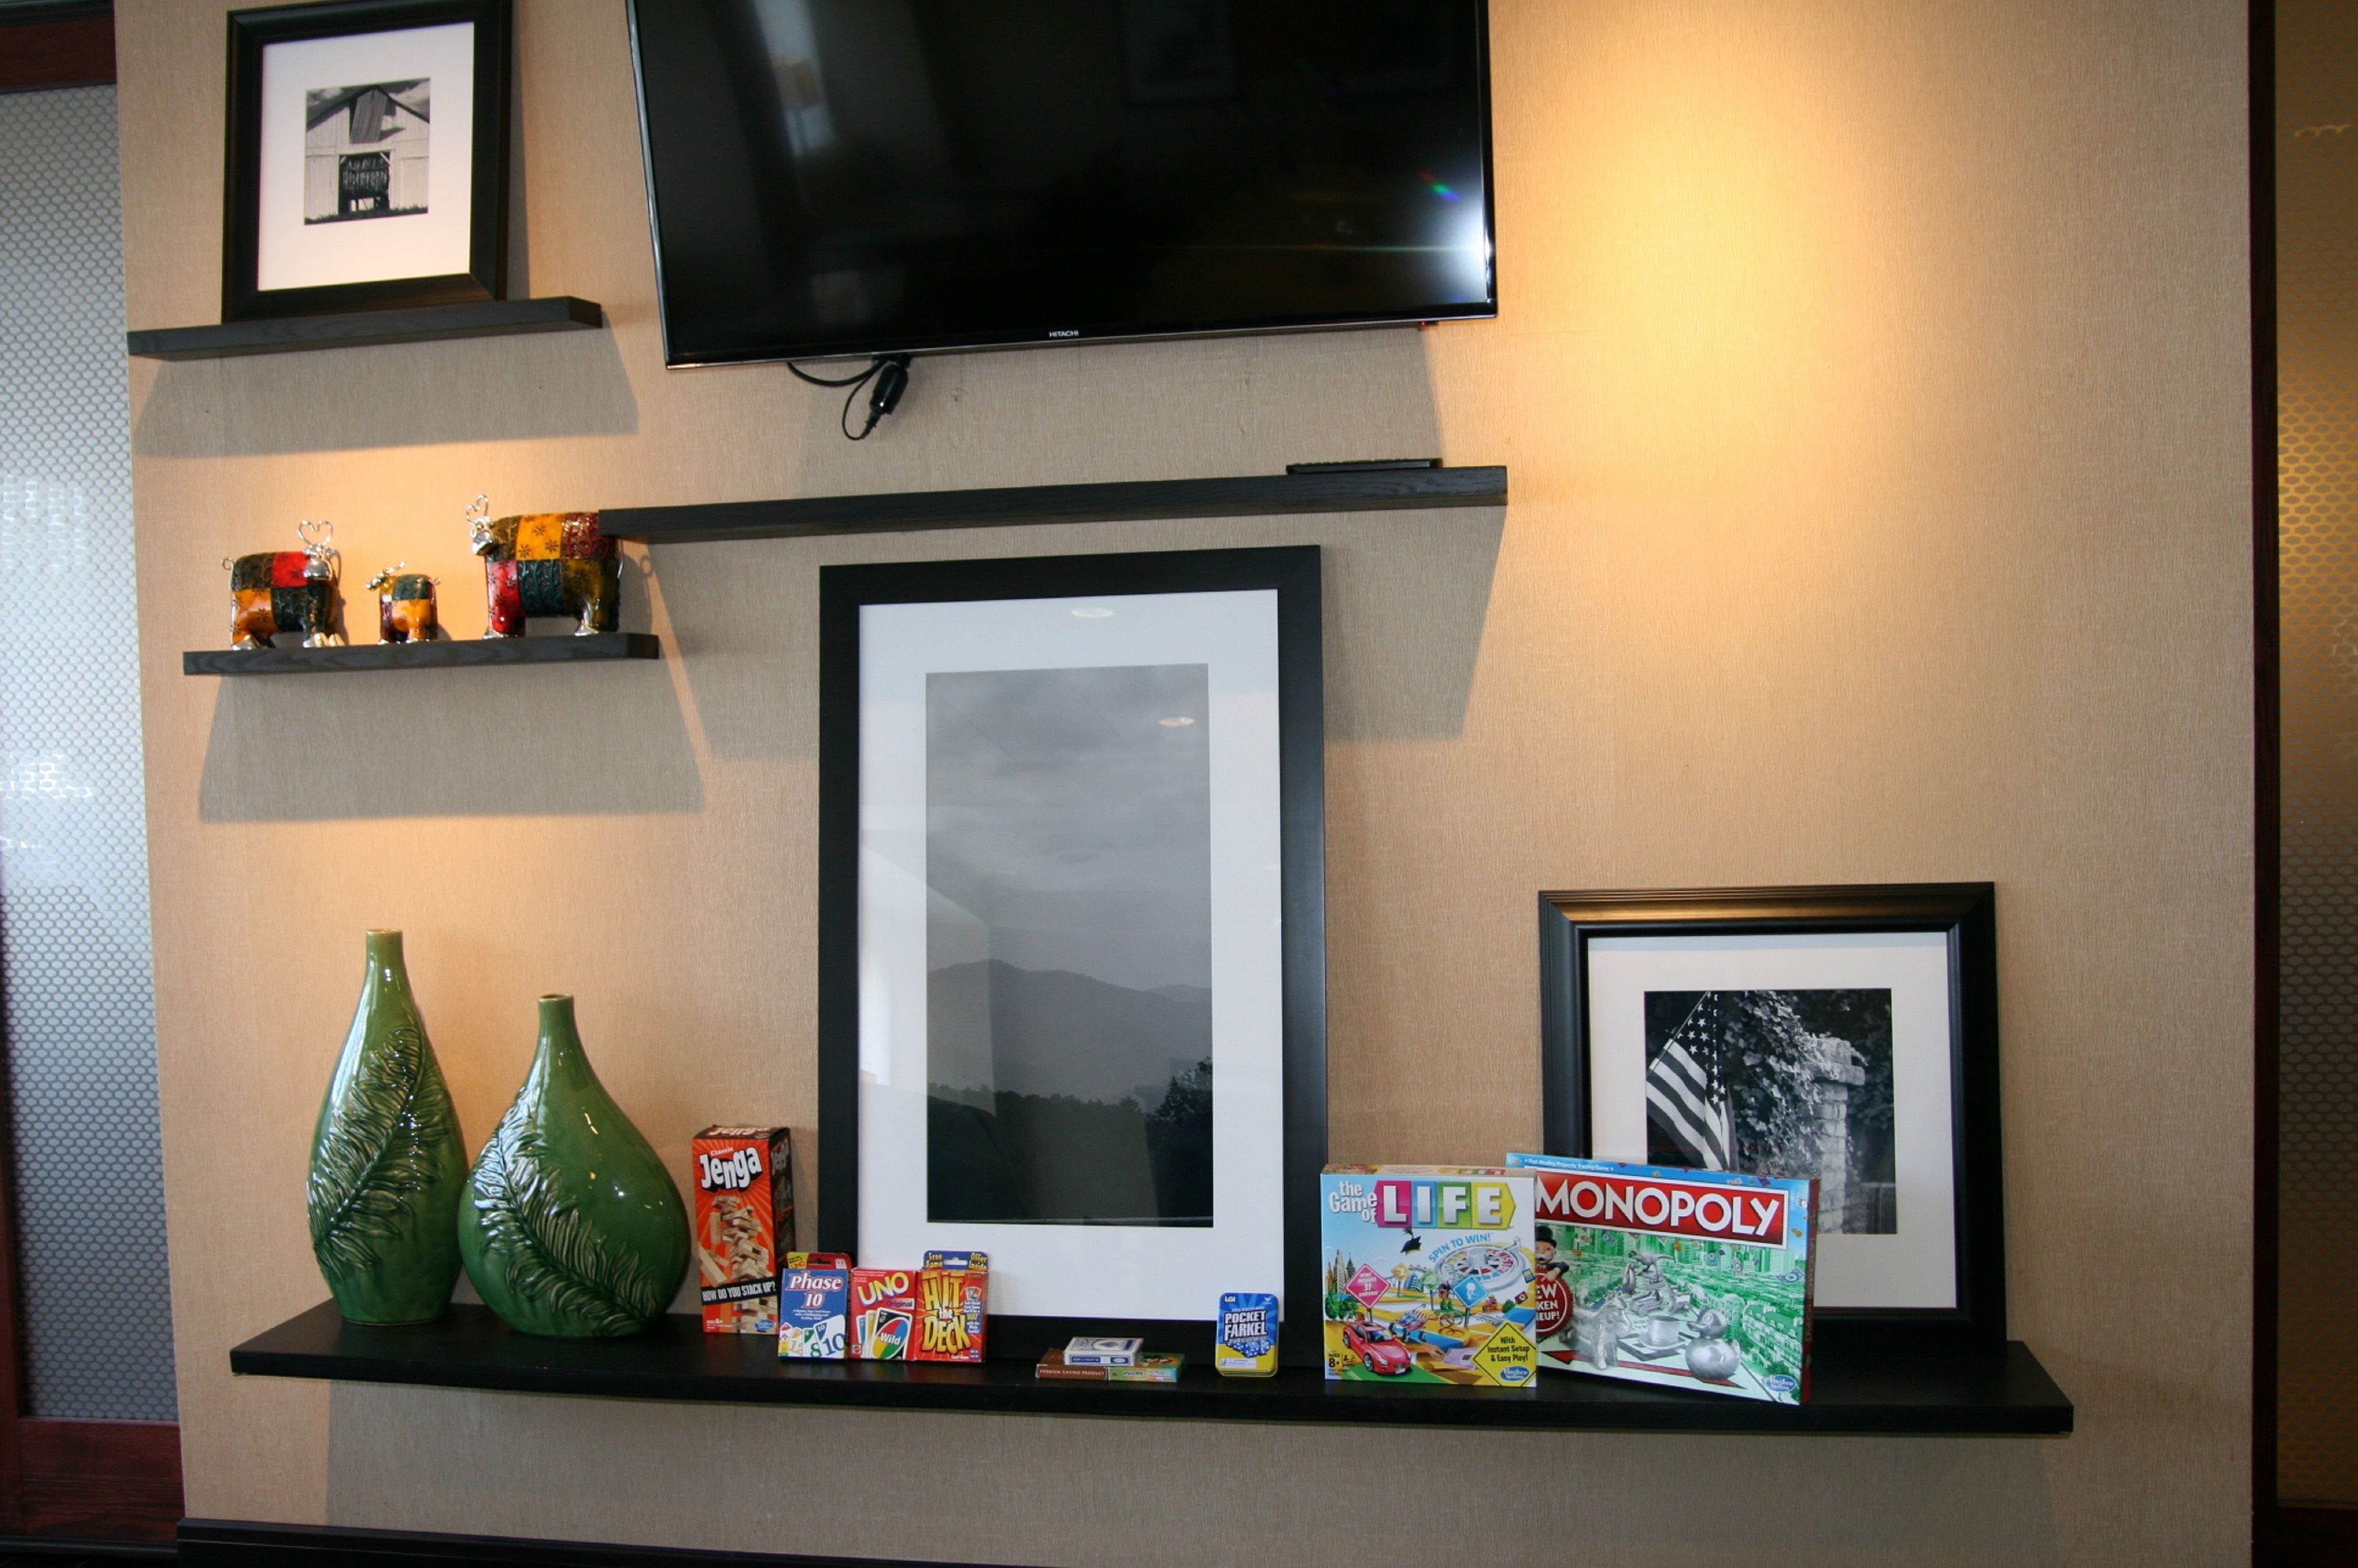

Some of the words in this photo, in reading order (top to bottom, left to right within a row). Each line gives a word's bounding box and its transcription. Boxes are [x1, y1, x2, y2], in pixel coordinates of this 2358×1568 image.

[710, 1146, 734, 1155] Classic
[699, 1147, 763, 1189] Jenga
[1339, 1181, 1362, 1196] the
[1329, 1191, 1377, 1213] Game
[1383, 1185, 1501, 1224] LIFE
[1536, 1175, 1780, 1236] MONOPOLY
[1362, 1209, 1377, 1223] of
[1428, 1243, 1450, 1262] SPIN
[1450, 1238, 1463, 1248] TO
[1465, 1233, 1491, 1243] WIN!
[968, 1260, 987, 1270] Inside
[970, 1252, 987, 1263] Offer
[786, 1271, 843, 1291] Phase
[857, 1272, 909, 1306] UNO
[702, 1290, 717, 1301] HOW
[717, 1289, 728, 1300] DO
[727, 1286, 741, 1298] YOU
[741, 1283, 763, 1296] STACK
[762, 1281, 776, 1293] UP?
[921, 1271, 965, 1311] HIT
[1536, 1283, 1557, 1299] EW
[802, 1292, 825, 1308] 10
[1536, 1300, 1558, 1310] KEN
[938, 1305, 953, 1320] the
[1224, 1310, 1266, 1324] POCKET
[1536, 1311, 1560, 1321] EUP!
[880, 1332, 902, 1346] Wild
[921, 1314, 971, 1354] DECK
[1224, 1322, 1267, 1341] FARKEL
[823, 1333, 846, 1356] 10
[1511, 1345, 1530, 1353] Setup
[1328, 1357, 1340, 1368] 8+
[1496, 1354, 1511, 1364] Easy
[1512, 1353, 1528, 1362] Play!
